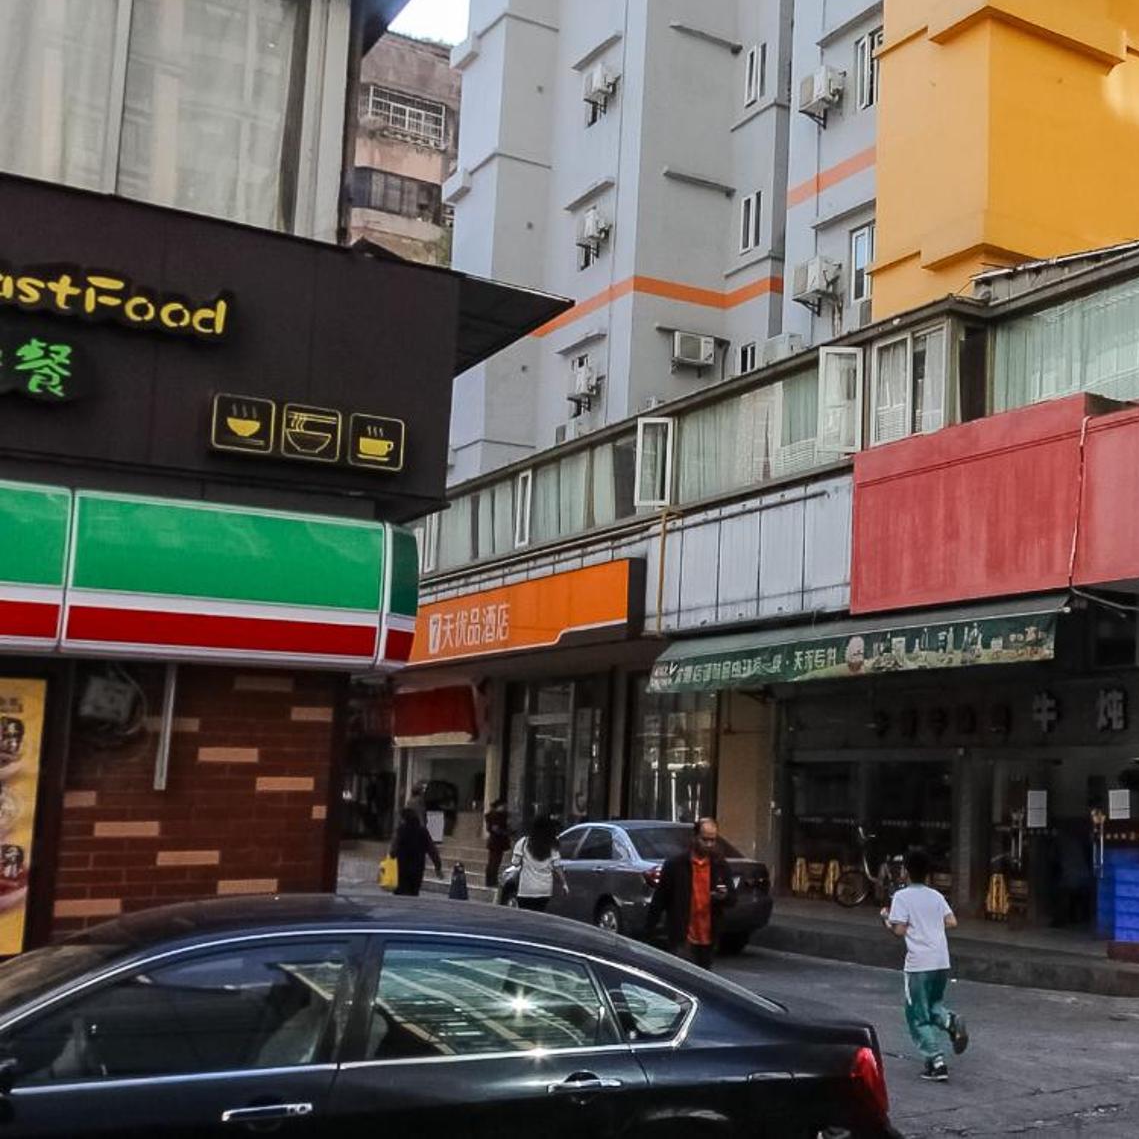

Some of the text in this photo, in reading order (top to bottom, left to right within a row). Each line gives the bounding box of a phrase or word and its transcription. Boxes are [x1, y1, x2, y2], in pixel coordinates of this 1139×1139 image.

[428, 603, 511, 655] 7天优品酒店
